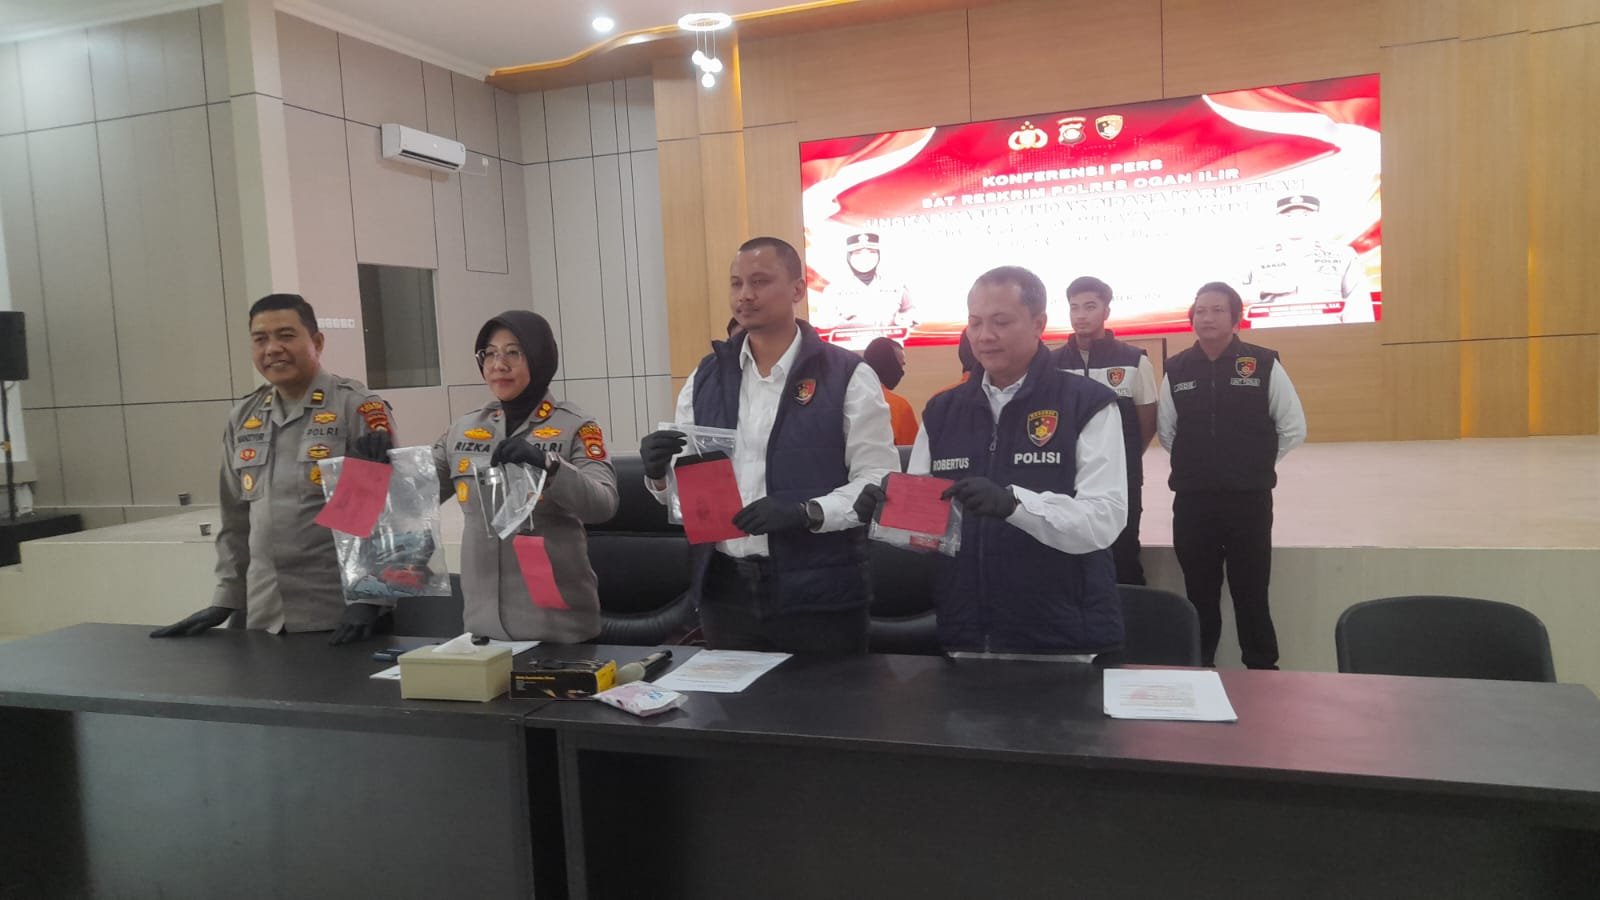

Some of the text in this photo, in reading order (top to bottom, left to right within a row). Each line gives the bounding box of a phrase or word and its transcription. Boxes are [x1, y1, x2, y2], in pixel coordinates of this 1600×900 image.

[982, 159, 1163, 187] KONFERENSI PERS
[922, 168, 1240, 209] SAT RESKRIM POLRES OGAN ILIR
[306, 427, 339, 437] POLRI
[454, 441, 491, 453] RIZKA
[534, 441, 563, 453] OLRI
[933, 457, 970, 471] ROBERTUS
[1014, 452, 1061, 465] POLISI
